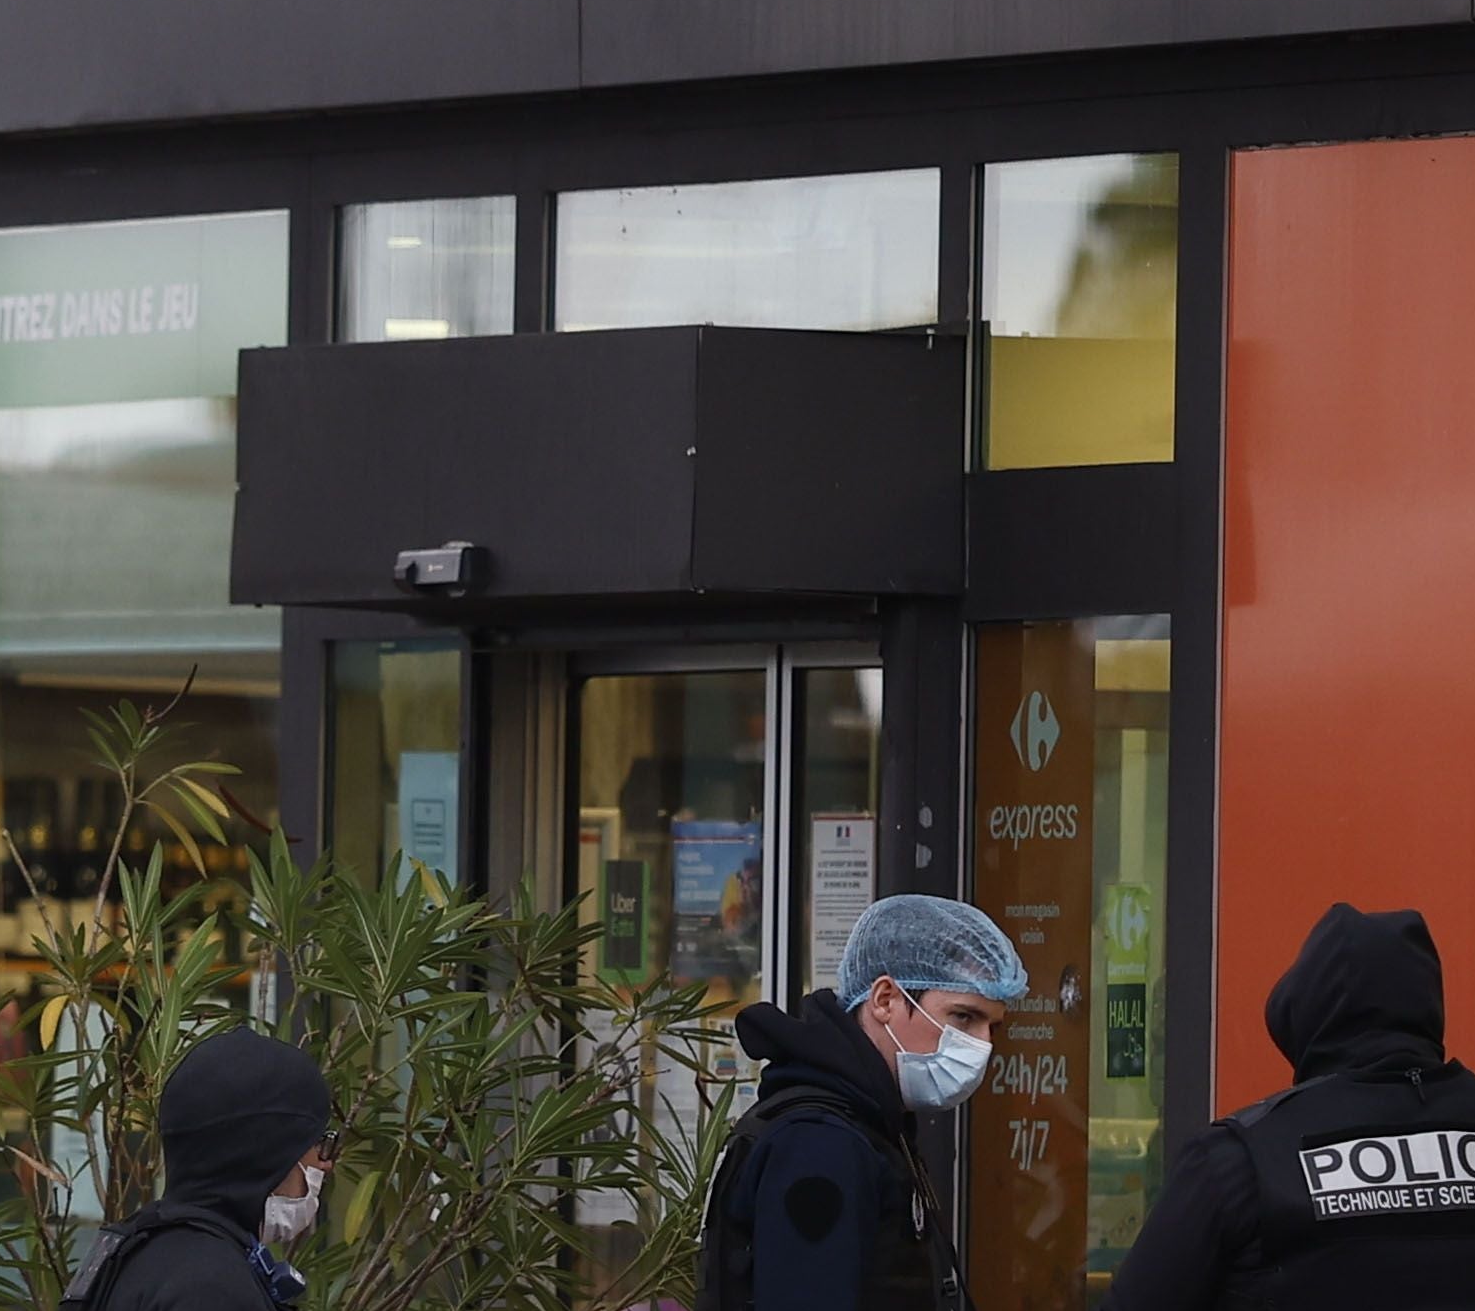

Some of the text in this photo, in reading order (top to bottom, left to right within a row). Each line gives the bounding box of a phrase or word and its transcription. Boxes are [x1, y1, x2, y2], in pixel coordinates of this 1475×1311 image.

[58, 289, 125, 339] DANS
[127, 285, 154, 334] LE
[157, 283, 199, 331] JEU
[990, 803, 1079, 851] express
[611, 892, 637, 914] Uber
[1008, 1023, 1055, 1040] dimanche
[1108, 999, 1144, 1029] HALAL
[992, 1052, 1069, 1105] 24h/24
[1009, 1117, 1050, 1171] 7j/7
[1315, 1190, 1413, 1215] TECHNIQUE
[1414, 1187, 1434, 1207] ET
